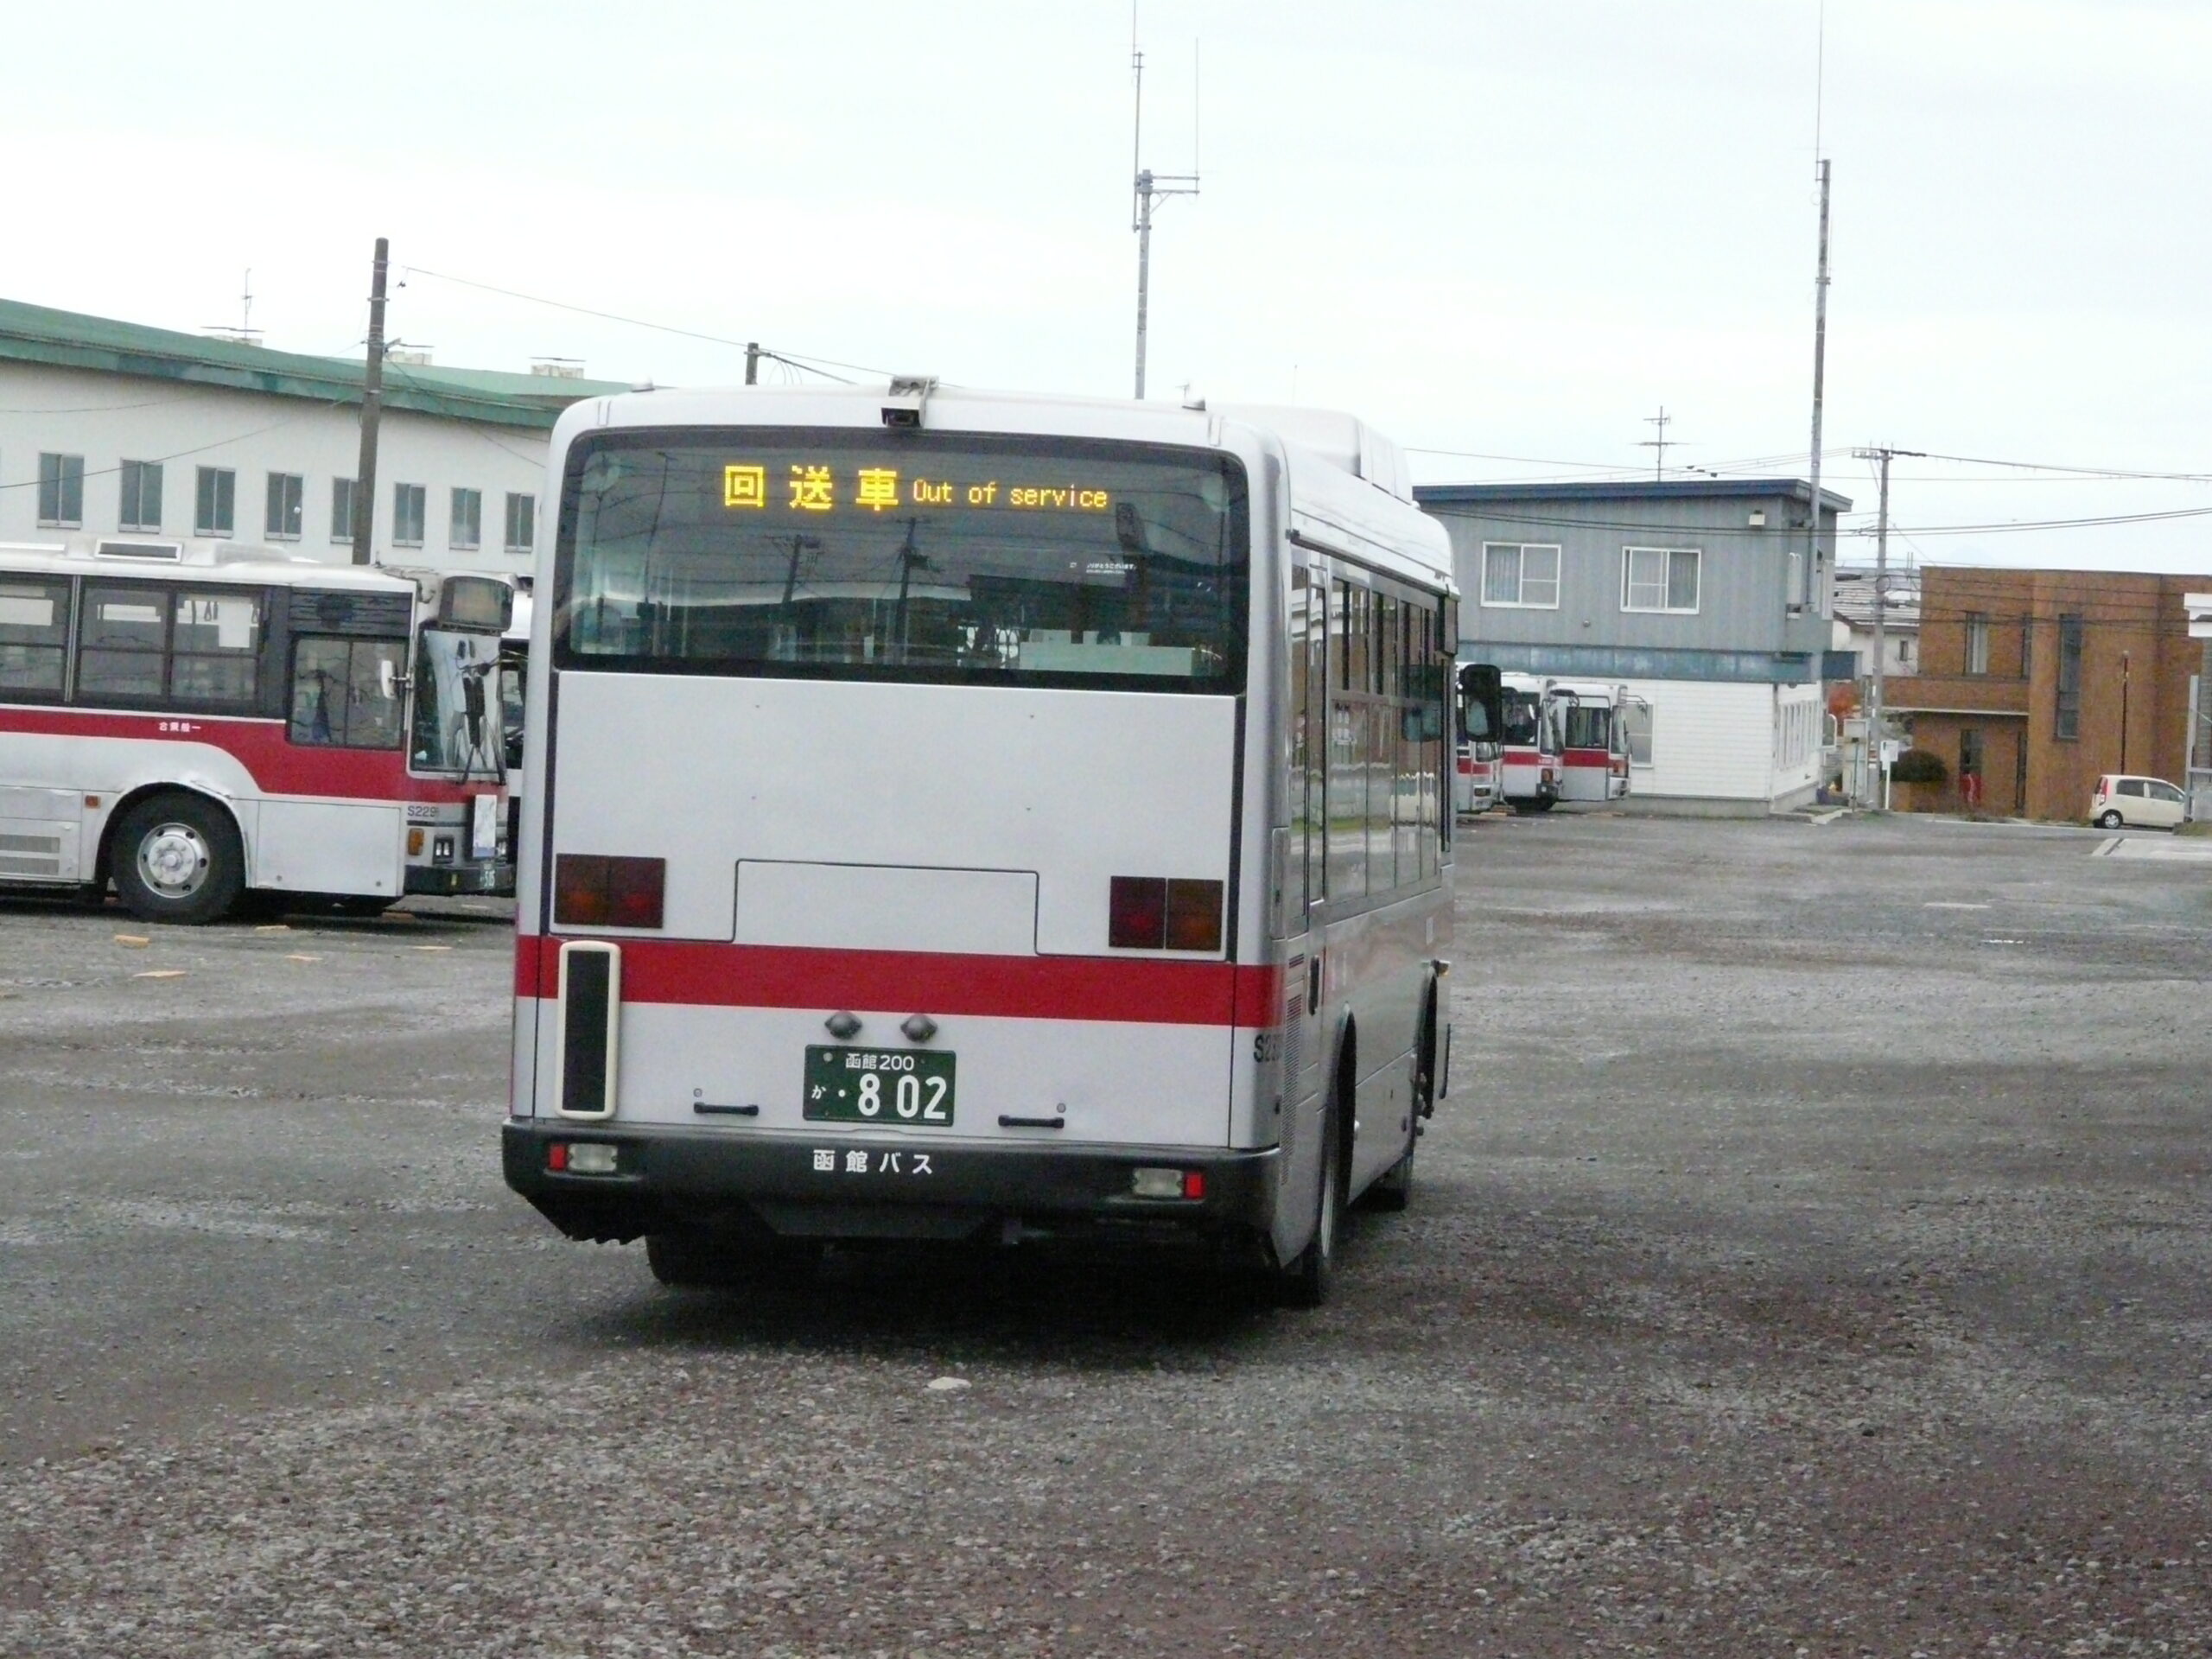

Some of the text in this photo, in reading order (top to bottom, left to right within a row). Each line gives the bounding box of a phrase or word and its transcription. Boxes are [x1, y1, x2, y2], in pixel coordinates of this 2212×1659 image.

[724, 464, 1109, 512] 回送車 Out of service
[810, 1084, 827, 1100] か
[813, 1149, 933, 1175] 函館バス
